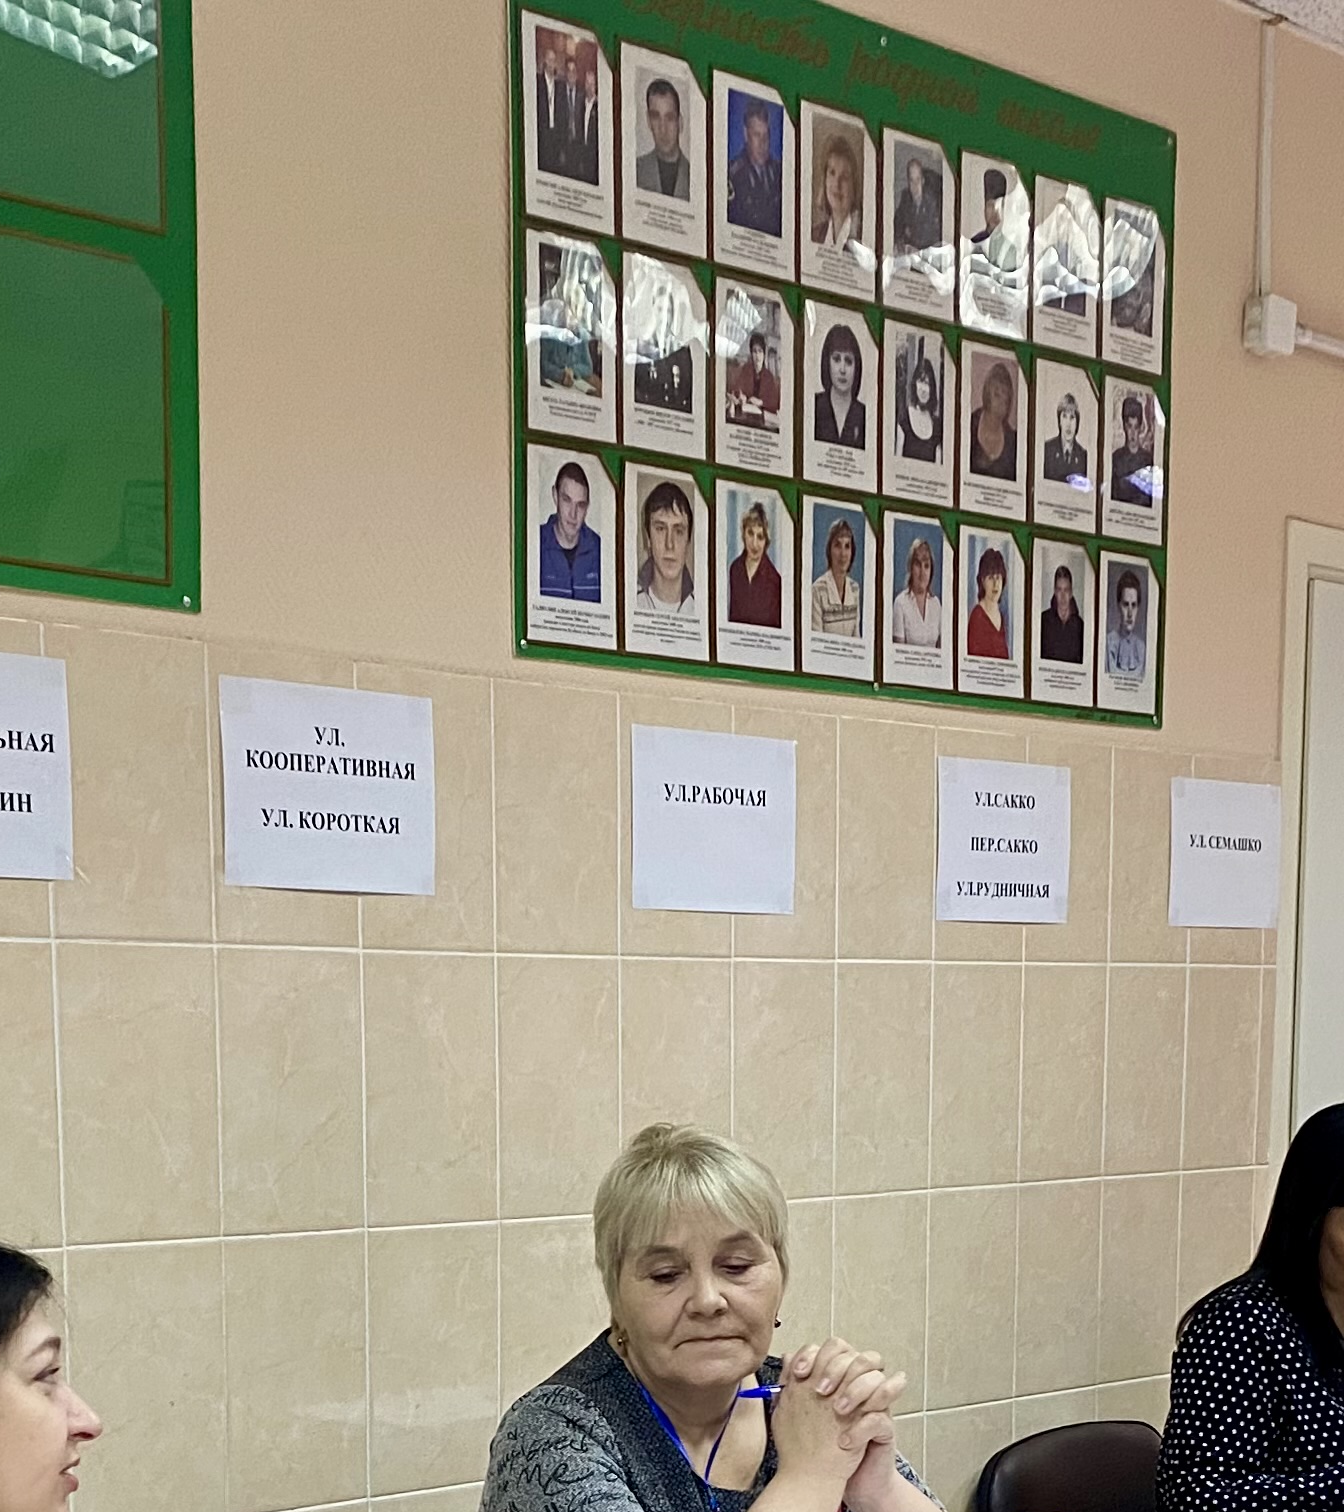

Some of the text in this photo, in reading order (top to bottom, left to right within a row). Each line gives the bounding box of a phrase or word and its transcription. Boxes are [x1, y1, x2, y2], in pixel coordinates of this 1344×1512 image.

[314, 726, 346, 747] УЛ.
[246, 749, 416, 780] КООПЕРАТИВНАЯ
[664, 783, 766, 807] УЛ.РАБОЧАЯ
[974, 791, 1036, 810] УЛ.САККО
[261, 808, 401, 834] УЛ. КОРОТКАЯ
[971, 836, 1038, 854] ПЕР.САККО
[956, 881, 1050, 899] УЛ.РУДНИЧНАЯ
